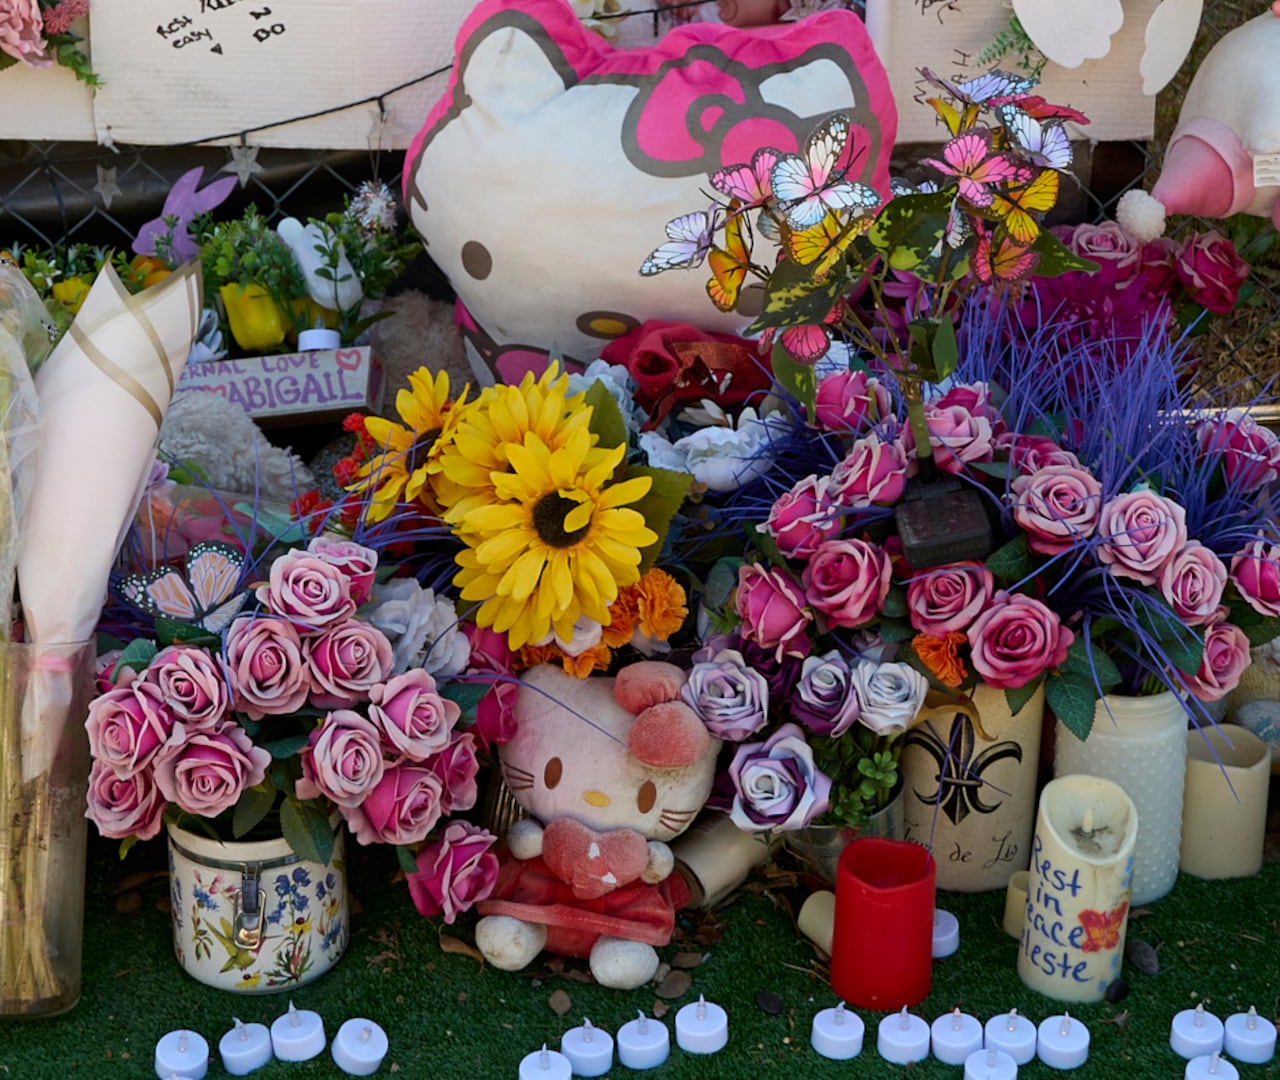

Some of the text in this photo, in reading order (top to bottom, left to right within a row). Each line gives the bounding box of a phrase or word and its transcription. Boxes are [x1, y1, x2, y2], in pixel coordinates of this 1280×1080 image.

[171, 27, 214, 50] easy
[179, 351, 320, 381] ERNAL LOVE
[229, 368, 364, 412] ABIGAIL
[1032, 833, 1083, 897] Rest
[1036, 881, 1063, 917] in
[1025, 899, 1084, 950] eace
[1020, 929, 1094, 983] leste
